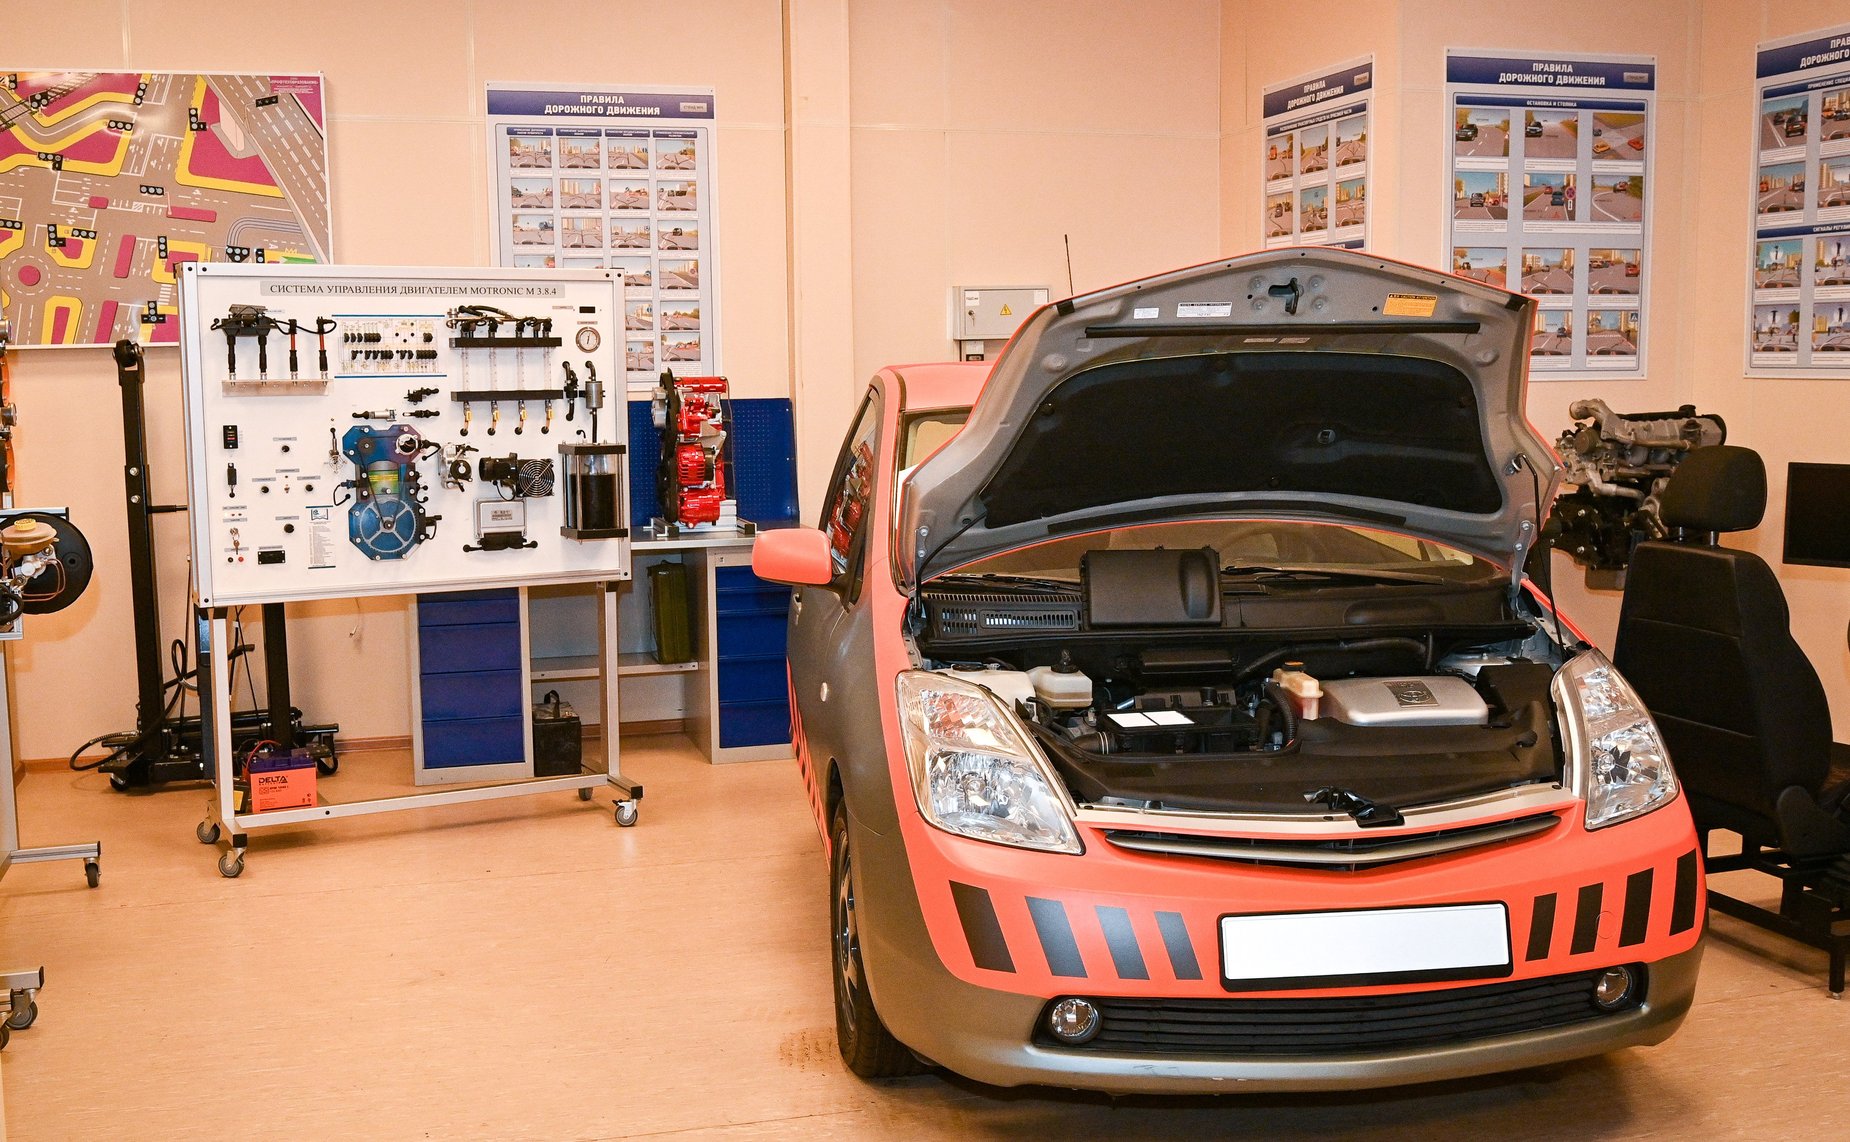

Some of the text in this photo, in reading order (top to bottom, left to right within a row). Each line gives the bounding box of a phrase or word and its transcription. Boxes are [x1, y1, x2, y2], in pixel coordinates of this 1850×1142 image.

[1800, 49, 1850, 68] ДОРОЖНОГО
[1532, 62, 1573, 73] ПРАВИЛА
[1498, 72, 1606, 86] ДОРОЖНОГО ДВИЖЕНИЯ
[1303, 80, 1326, 93] ПРАВИЛА
[580, 95, 625, 104] ПРАВИЛА
[1287, 85, 1344, 111] ДОРОЖНОГО ДВИЖЕНИЯ
[544, 104, 660, 116] ДОРОЖНОГО ДВИЖЕНИЯ
[269, 284, 557, 296] СИСТЕМА УПРАВЛЕНИЯ ДВИГАТЕЛЕМ MOTRONIC M 3.8.4
[258, 775, 288, 784] DELTA
